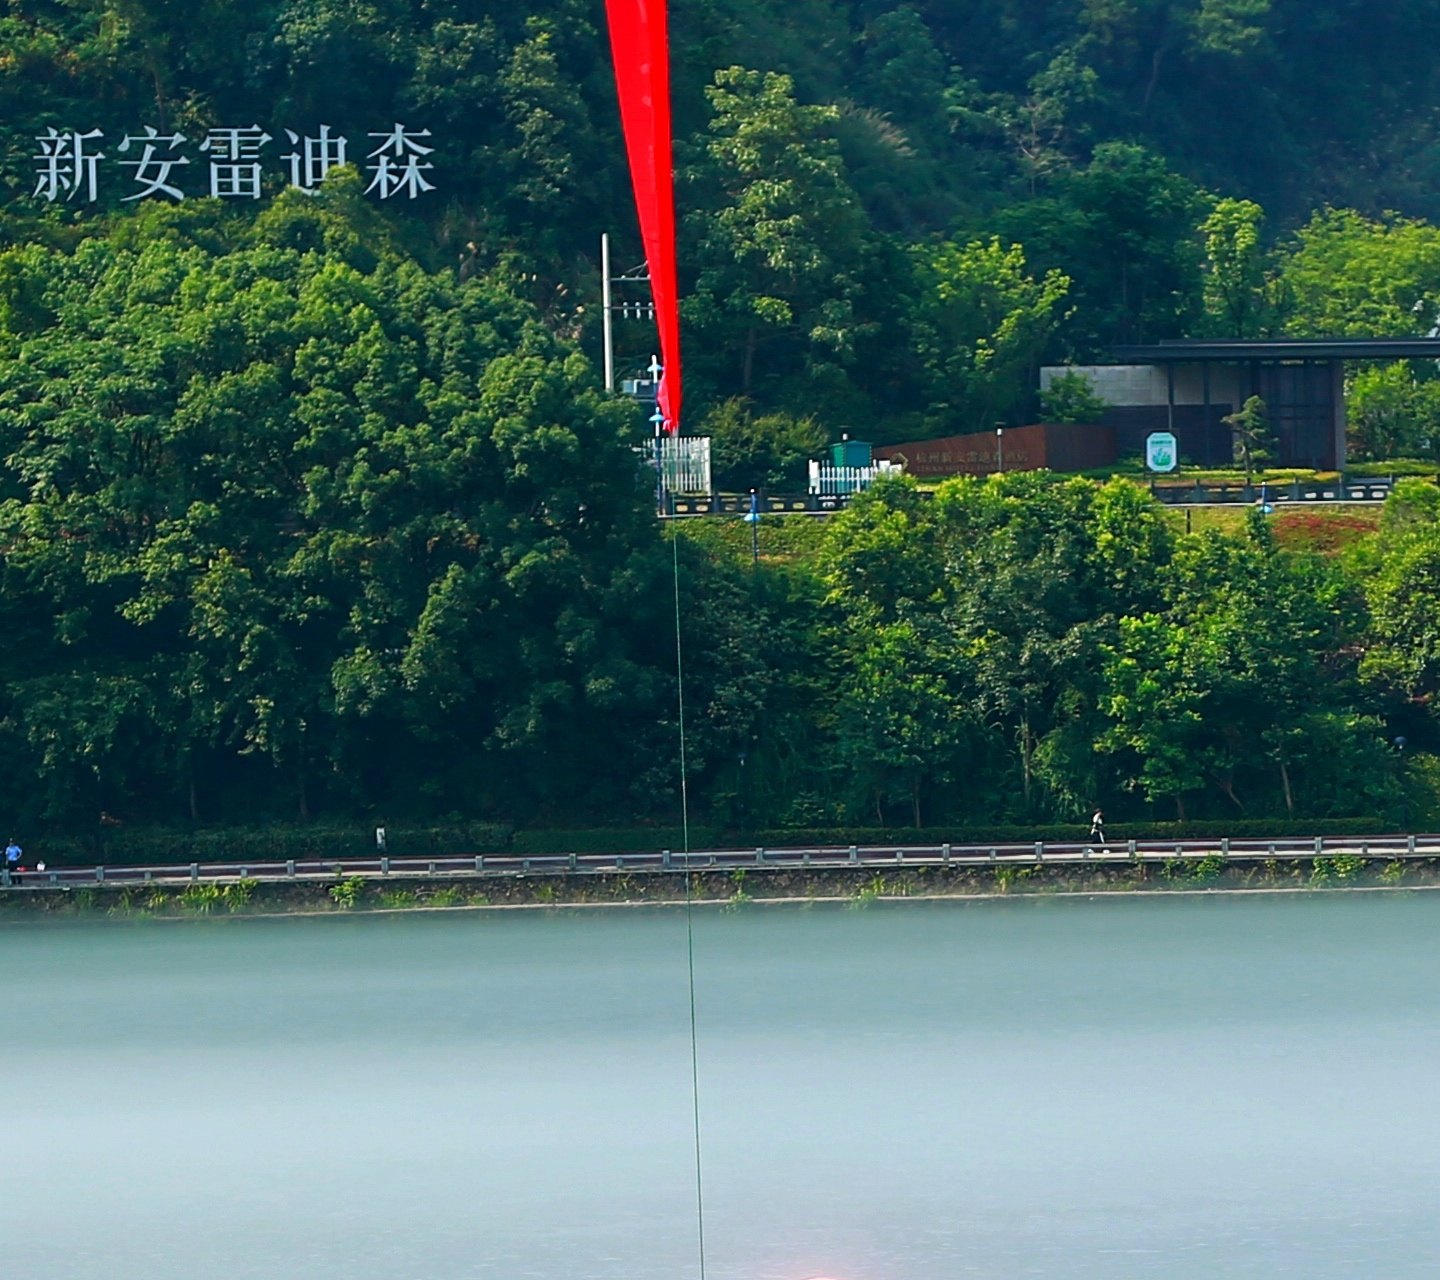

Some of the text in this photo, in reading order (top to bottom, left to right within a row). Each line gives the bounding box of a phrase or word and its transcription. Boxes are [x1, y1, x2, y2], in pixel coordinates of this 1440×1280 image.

[33, 122, 437, 202] 新安雷迪森
